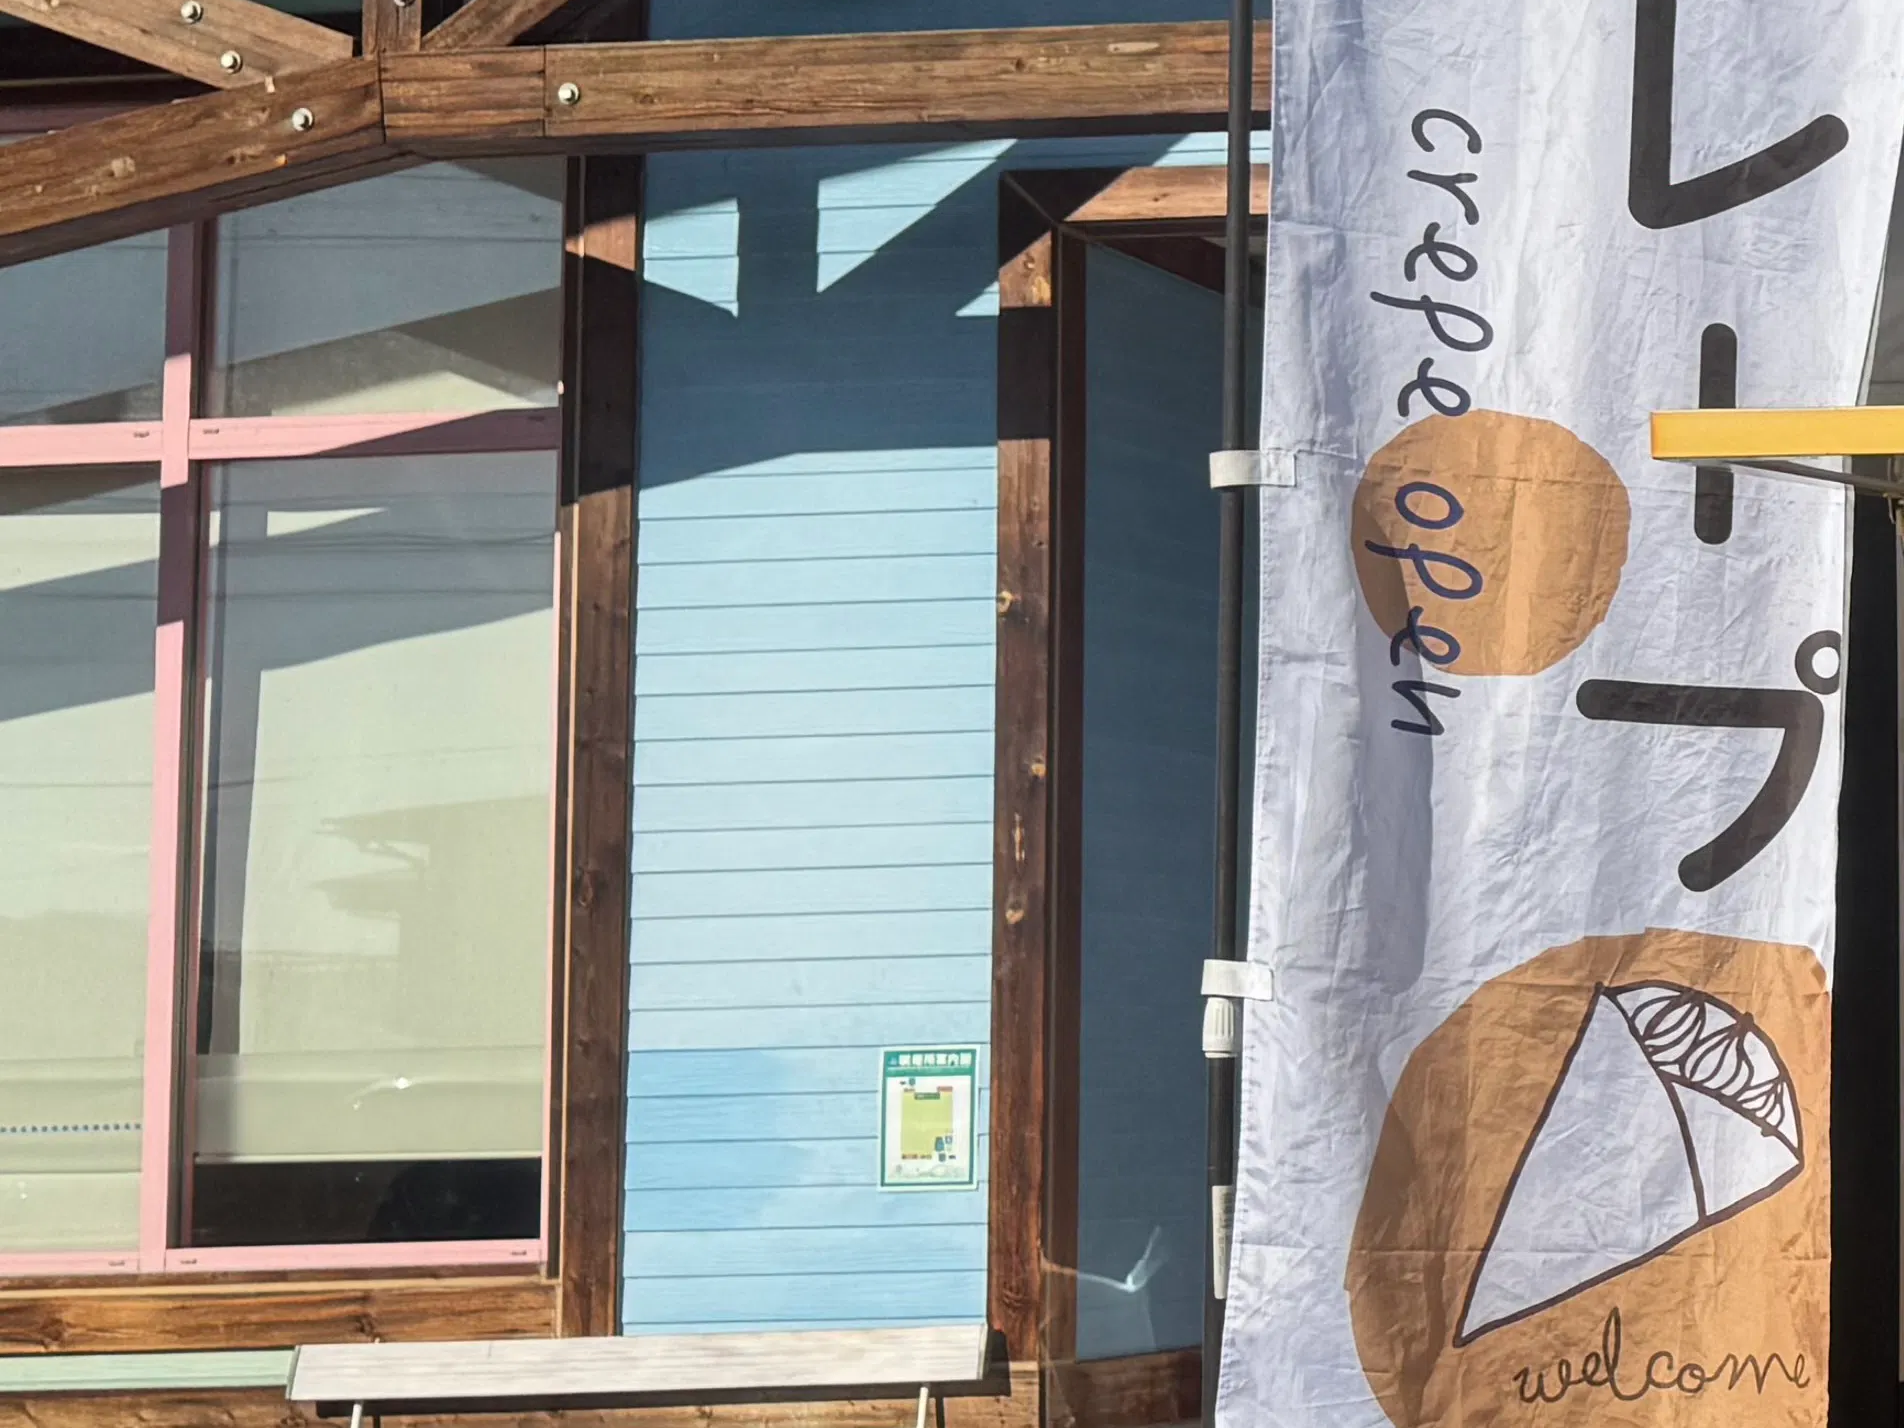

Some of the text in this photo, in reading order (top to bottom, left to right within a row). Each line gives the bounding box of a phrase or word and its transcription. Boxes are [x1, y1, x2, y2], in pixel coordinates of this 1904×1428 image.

[1364, 108, 1495, 736] crepe open
[1513, 1305, 1811, 1404] welcome
